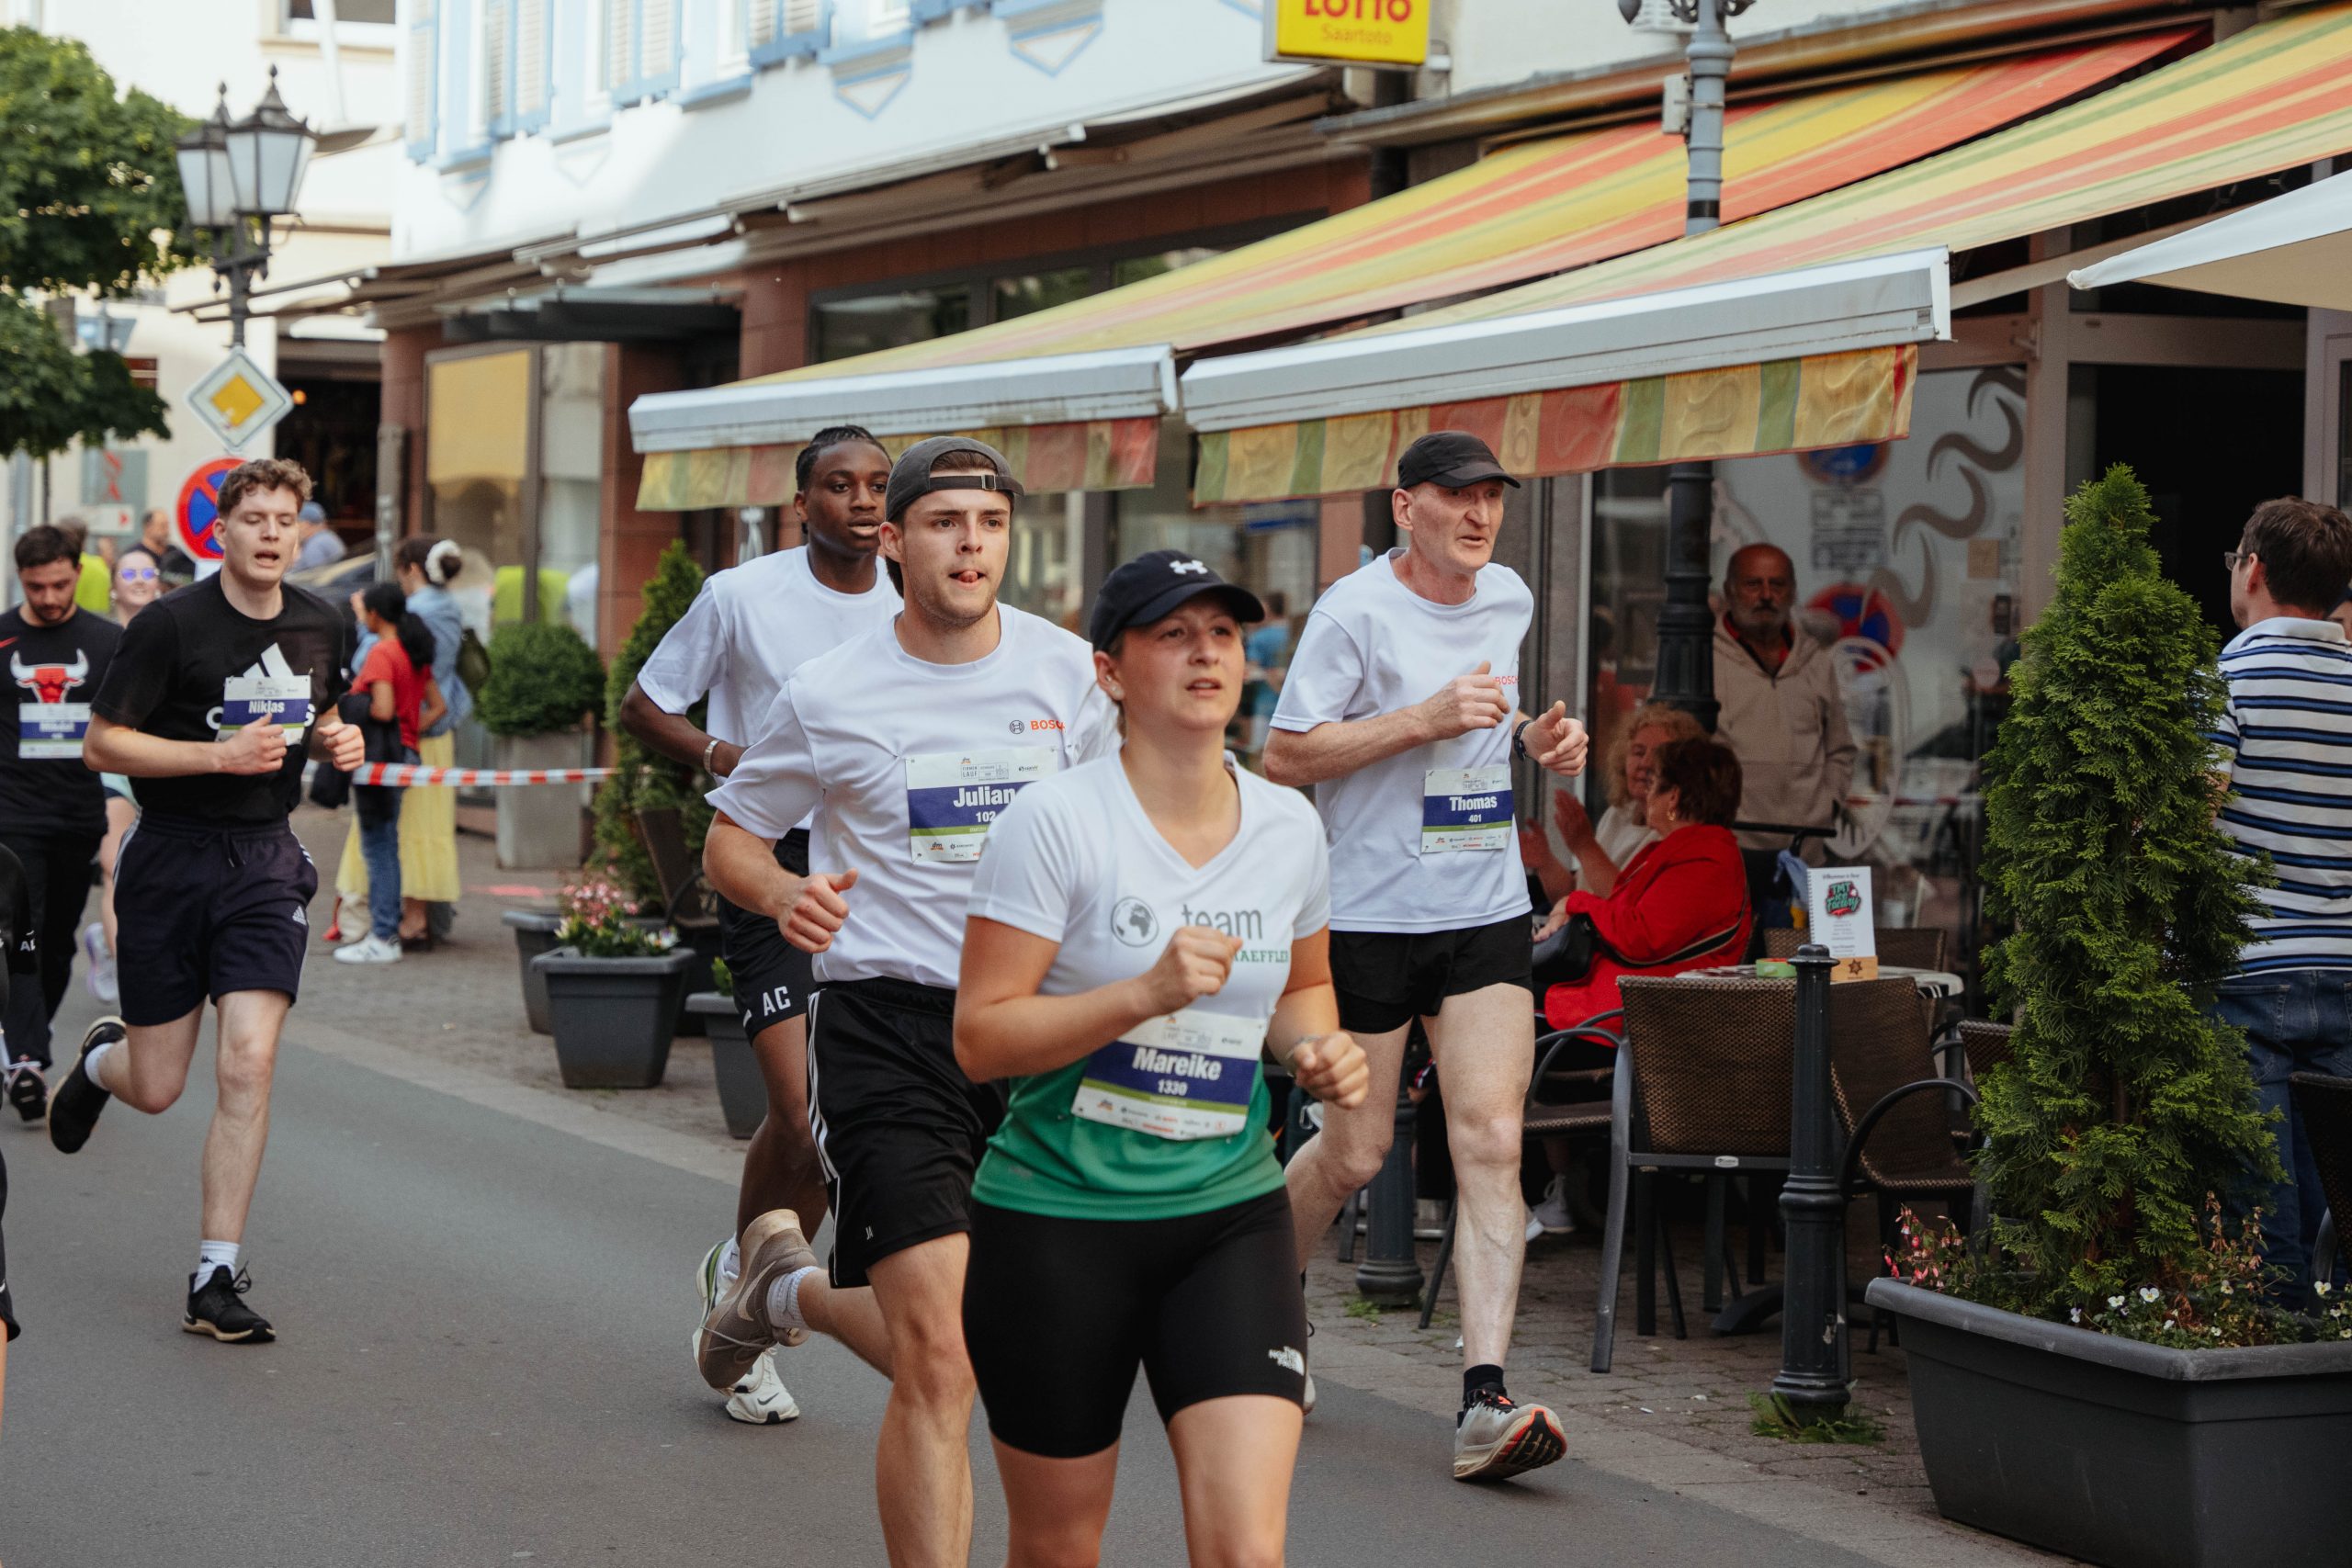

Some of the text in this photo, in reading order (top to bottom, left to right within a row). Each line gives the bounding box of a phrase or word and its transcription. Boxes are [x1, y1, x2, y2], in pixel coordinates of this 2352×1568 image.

[1321, 23, 1393, 44] Saartoto
[248, 700, 286, 714] Niklas
[953, 785, 1016, 807] Julian
[1449, 795, 1498, 812] Thomas
[1468, 814, 1482, 823] 401
[1182, 904, 1262, 940] team
[1235, 950, 1288, 963] AEFFLE
[763, 986, 791, 1017] AC
[1132, 1047, 1222, 1081] Mareike
[1158, 1079, 1188, 1096] 1330
